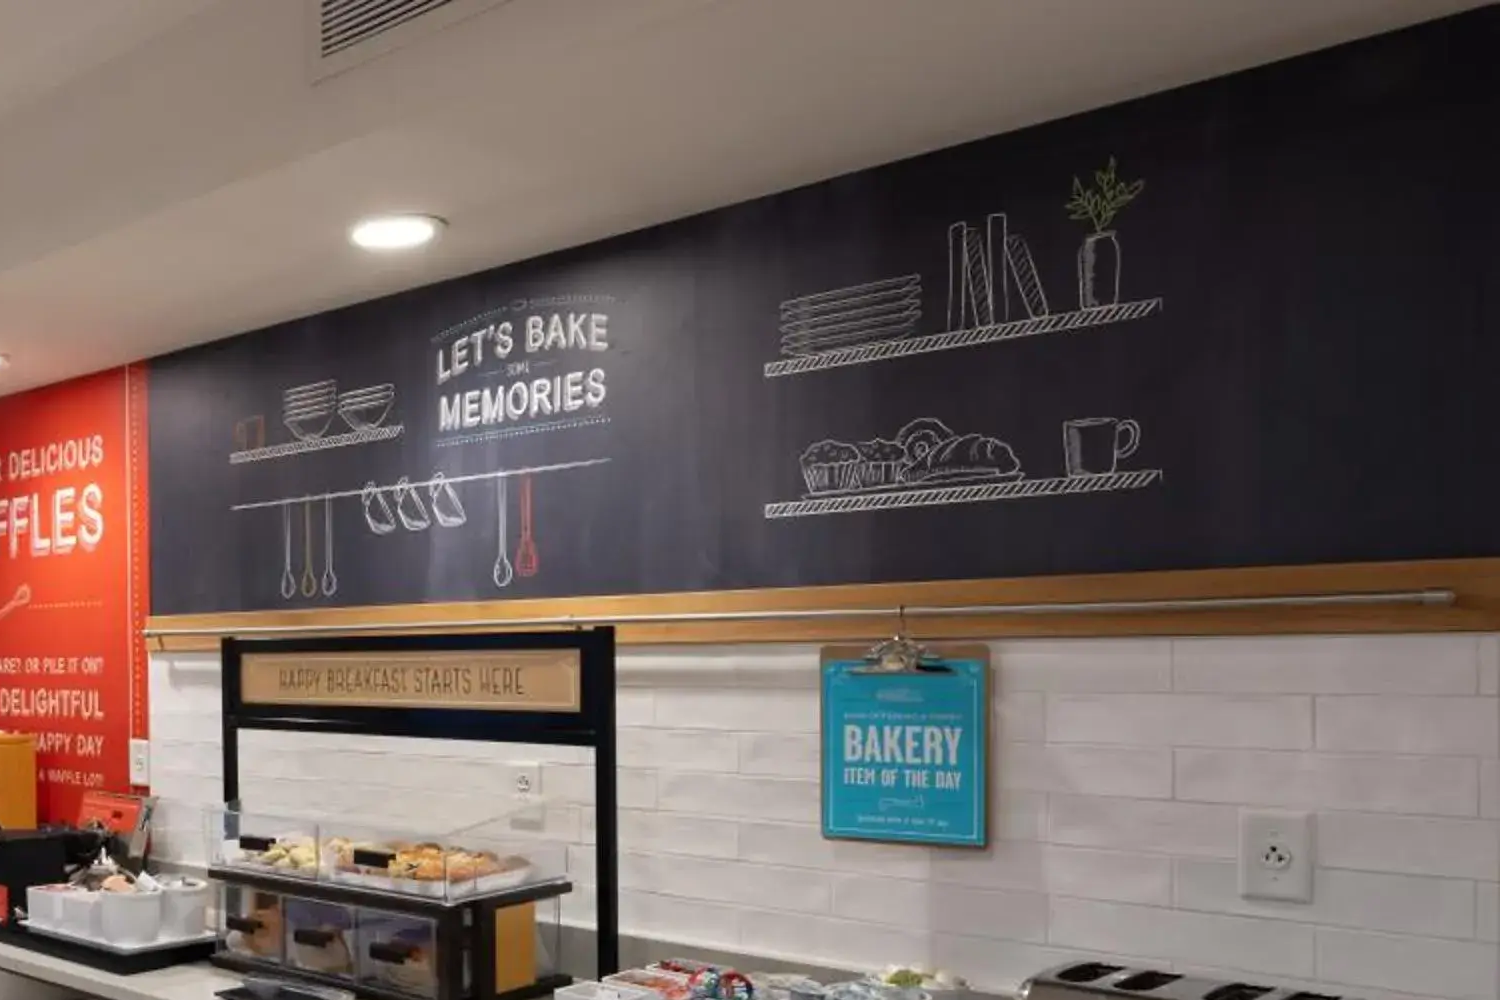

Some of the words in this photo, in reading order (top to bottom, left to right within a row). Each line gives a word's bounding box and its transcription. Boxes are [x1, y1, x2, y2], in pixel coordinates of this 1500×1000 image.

[437, 322, 513, 385] LET'S
[525, 312, 608, 353] BAKE
[438, 368, 606, 432] MEMORIES
[8, 434, 104, 481] DELICIOUS
[25, 656, 40, 674] OR
[43, 656, 65, 675] PILE
[280, 667, 321, 690] HAPPY
[326, 666, 408, 694] BREAKFAST
[414, 667, 472, 695] STARTS
[480, 667, 525, 696] HERE
[0, 687, 104, 721] DELIGHTFUL
[37, 732, 73, 754] APPY
[77, 734, 104, 757] DAY
[843, 724, 963, 766] BAKERY
[844, 767, 875, 785] ITEM
[881, 768, 898, 787] OF
[904, 770, 929, 788] THE
[935, 771, 962, 791] DAY
